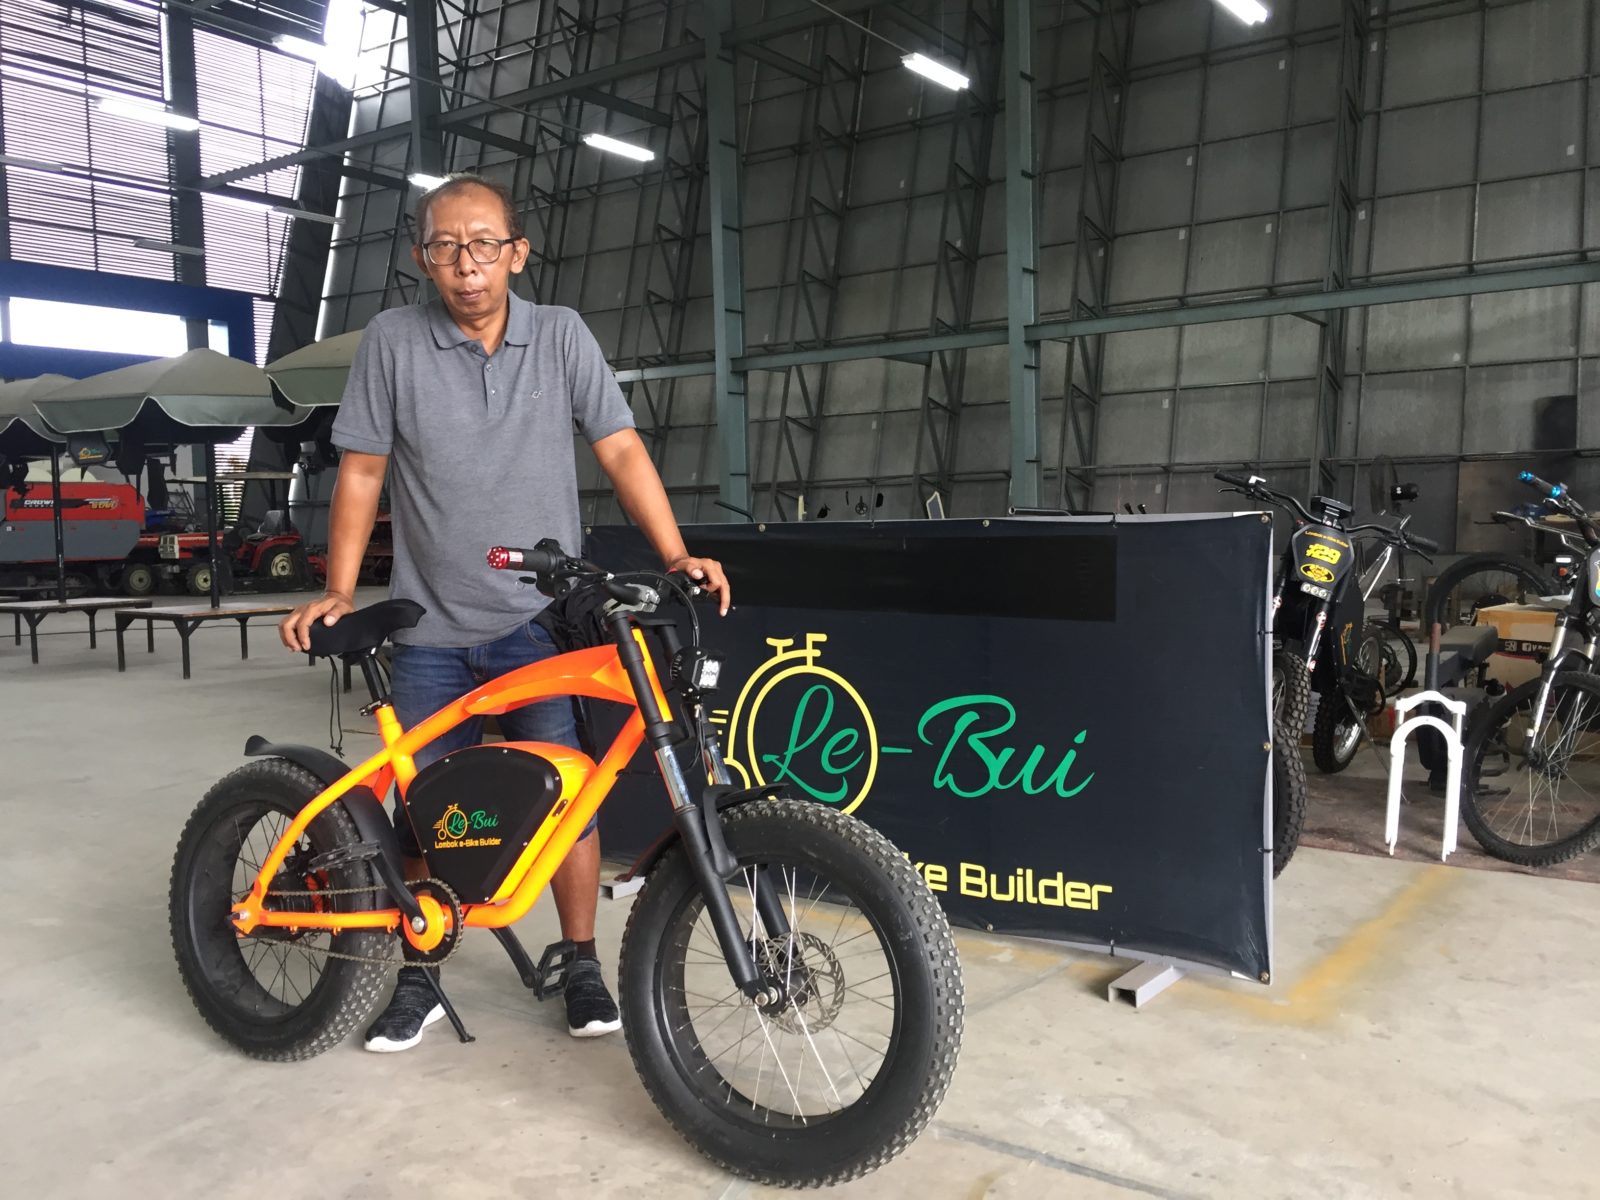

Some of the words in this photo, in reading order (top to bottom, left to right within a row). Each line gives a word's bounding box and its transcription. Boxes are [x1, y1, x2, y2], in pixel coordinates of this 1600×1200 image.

[434, 840, 458, 849] Lombok
[459, 838, 479, 848] e-Bike
[480, 838, 501, 847] Builder
[960, 862, 1112, 912] Builder
